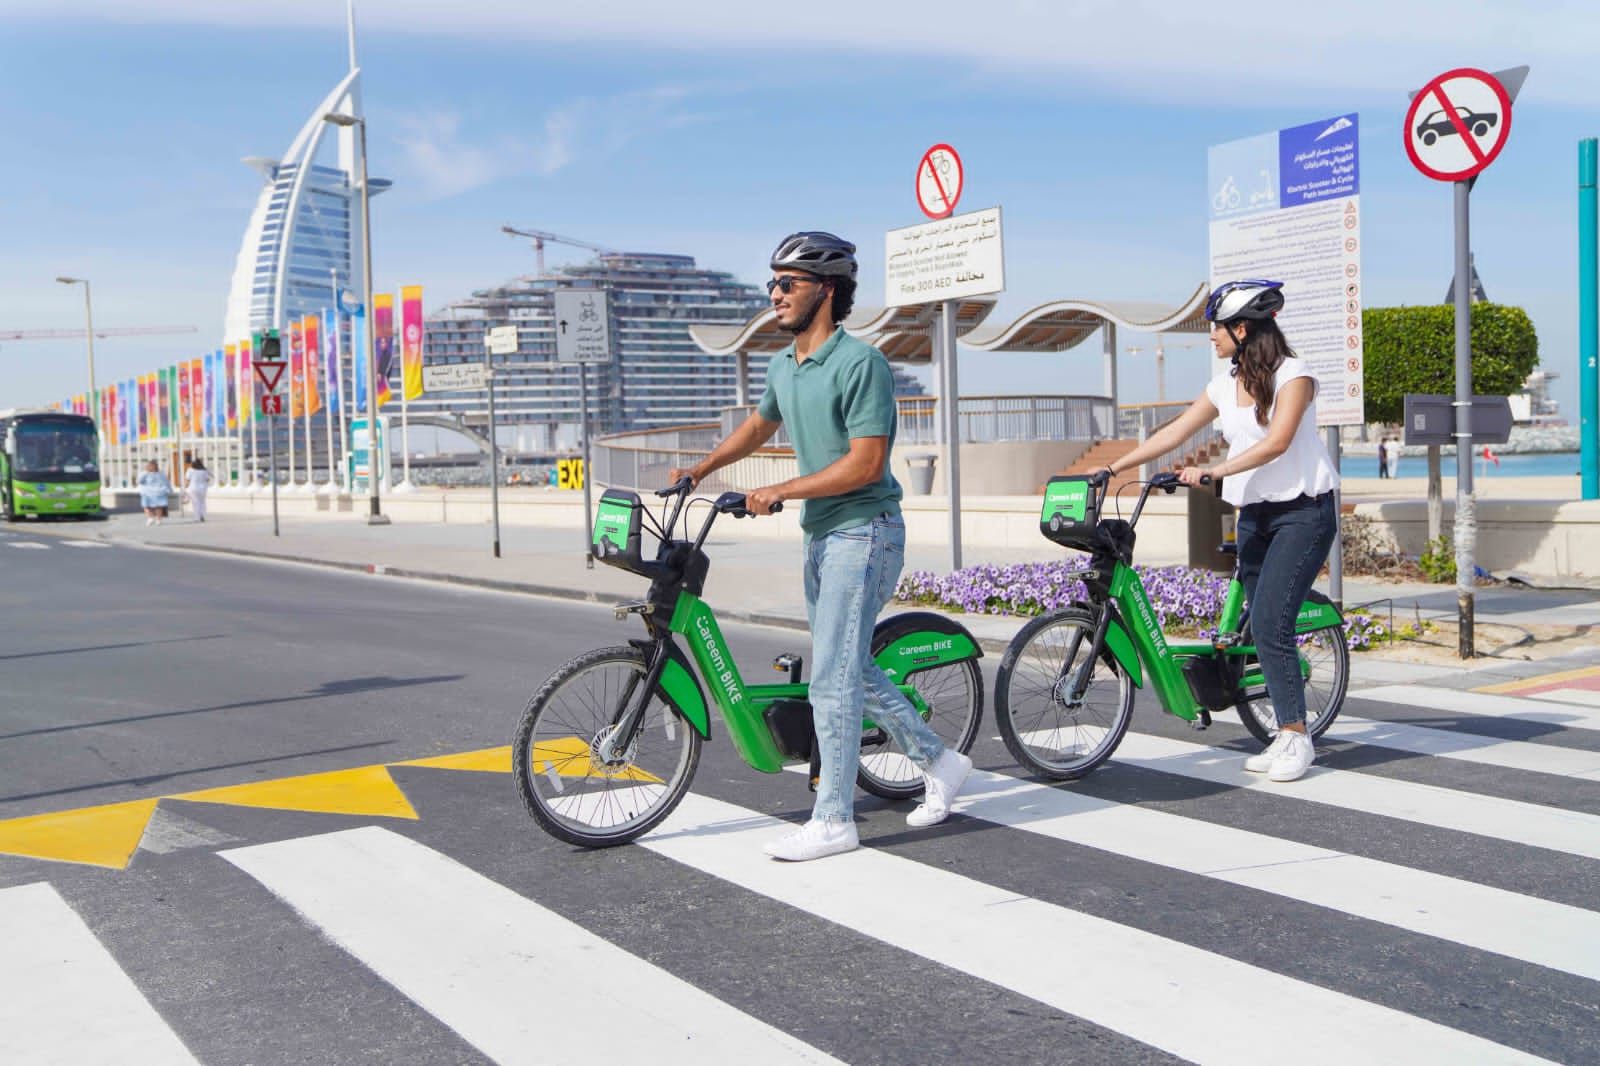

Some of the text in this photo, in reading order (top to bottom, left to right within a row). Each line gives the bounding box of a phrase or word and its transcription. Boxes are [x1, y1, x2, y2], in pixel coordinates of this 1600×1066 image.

[1287, 184, 1307, 194] Electric
[1308, 180, 1330, 190] Scooter
[1337, 175, 1354, 184] Cycle
[1303, 185, 1353, 199] Path Instructions
[901, 283, 915, 293] Fine
[918, 279, 933, 291] 300
[935, 277, 952, 288] AED
[1130, 581, 1168, 658] Careem BIKE
[1309, 608, 1322, 618] BIKE
[899, 640, 953, 656] Careem BIKE
[696, 615, 742, 705] Careem BIKE
